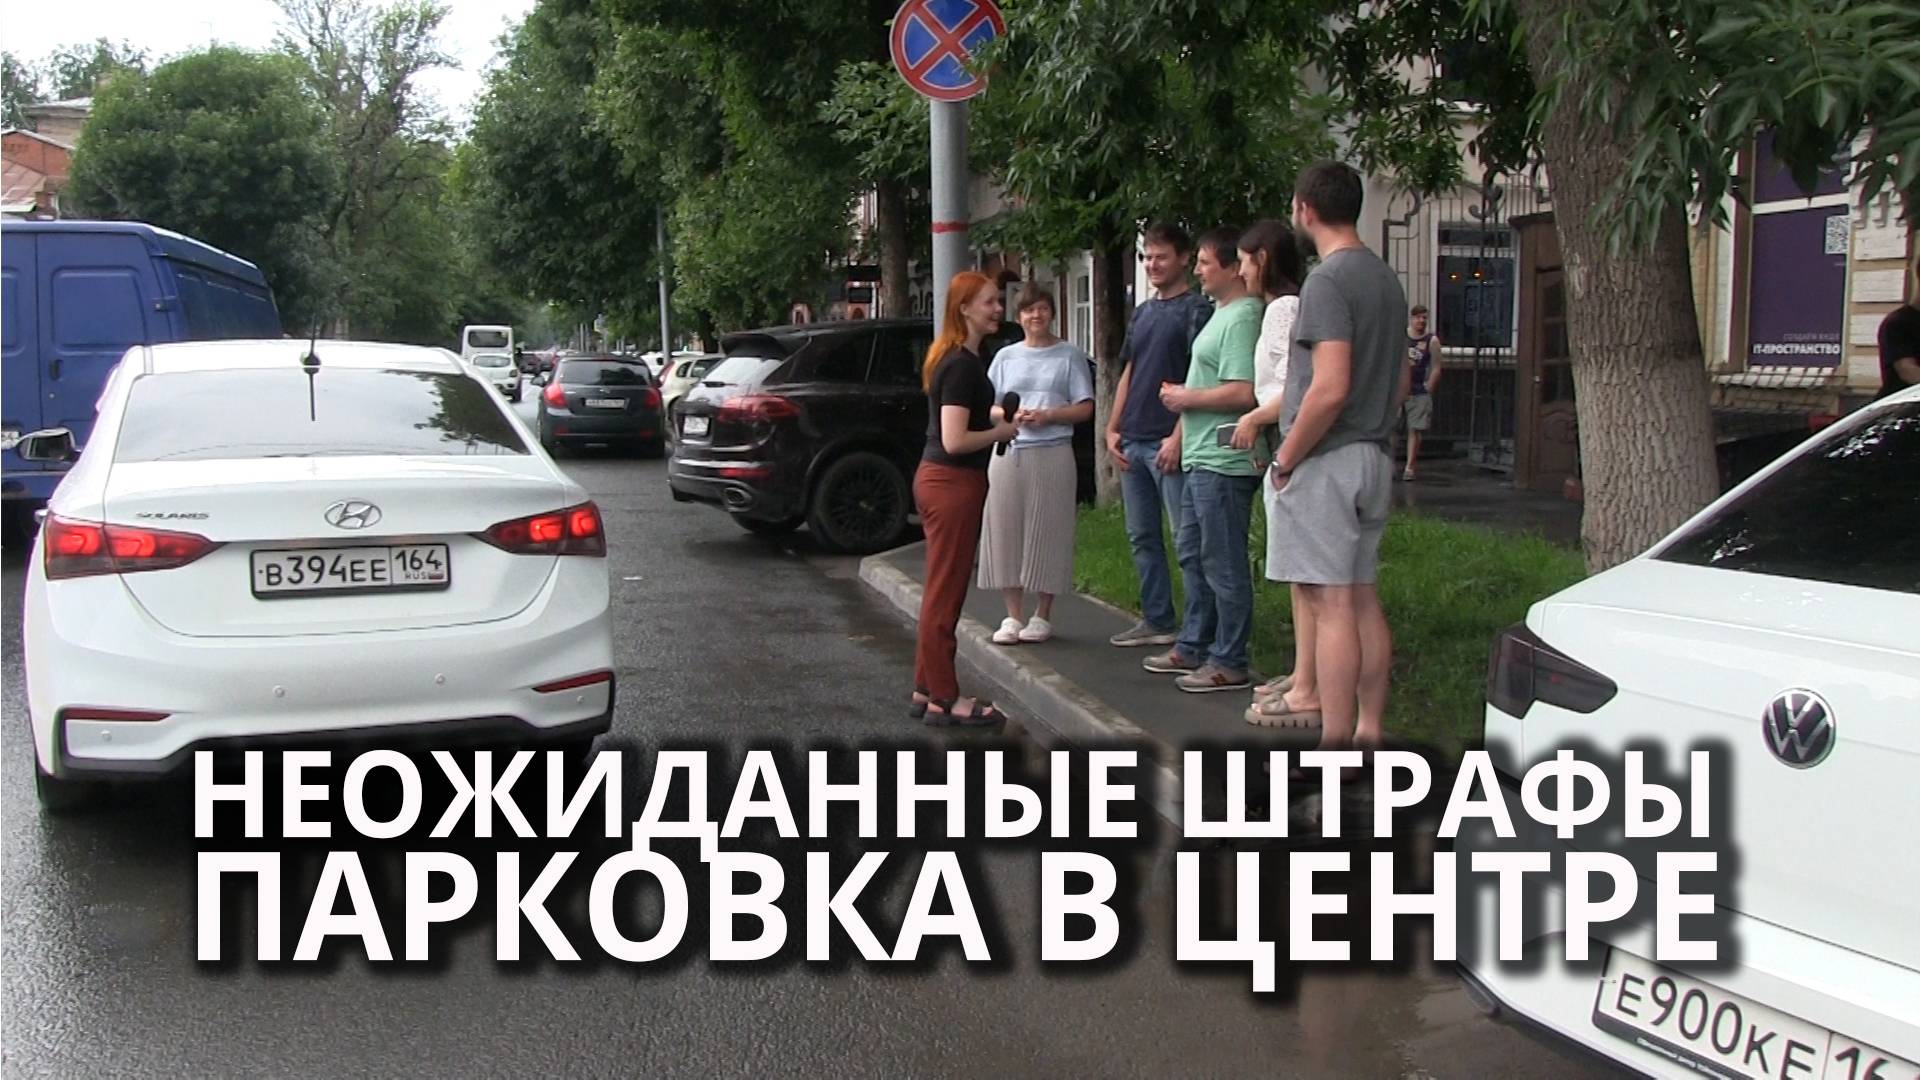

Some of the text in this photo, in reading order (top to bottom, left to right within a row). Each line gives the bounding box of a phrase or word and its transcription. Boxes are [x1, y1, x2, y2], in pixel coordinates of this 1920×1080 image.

[1752, 343, 1840, 354] IT-ПРОСТРАНСТВО
[395, 549, 443, 571] 164
[405, 572, 427, 580] RUS
